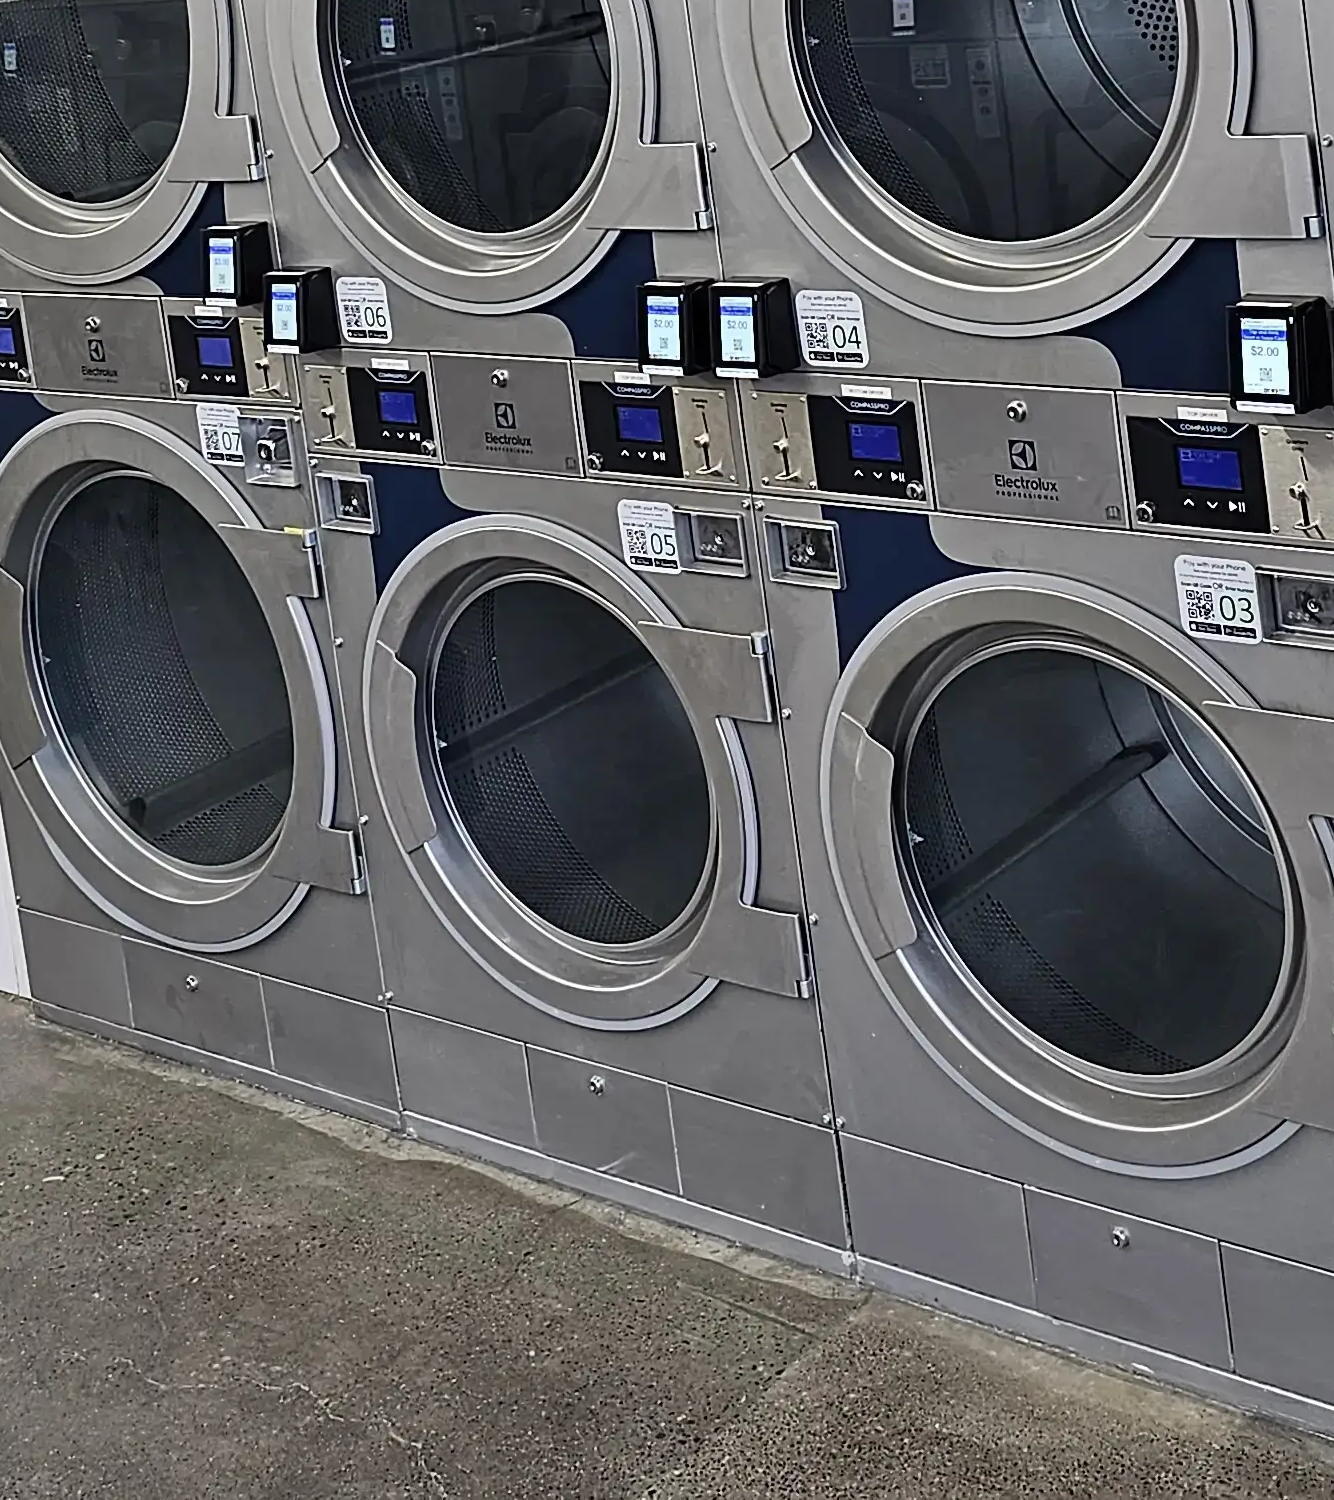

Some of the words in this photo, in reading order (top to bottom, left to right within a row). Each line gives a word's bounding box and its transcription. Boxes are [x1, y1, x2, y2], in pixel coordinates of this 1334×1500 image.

[364, 306, 387, 328] 06
[654, 319, 674, 329] $2.00
[727, 320, 748, 330] $2.00
[833, 324, 862, 350] 04
[1250, 346, 1279, 357] $2.00
[850, 400, 889, 411] COMPASSPRO
[1179, 423, 1228, 434] COMPASSPRO
[222, 431, 242, 451] 07
[485, 431, 532, 447] Electrolux
[994, 473, 1058, 493] Electrolux
[650, 532, 675, 556] 05
[1219, 595, 1254, 624] 03
